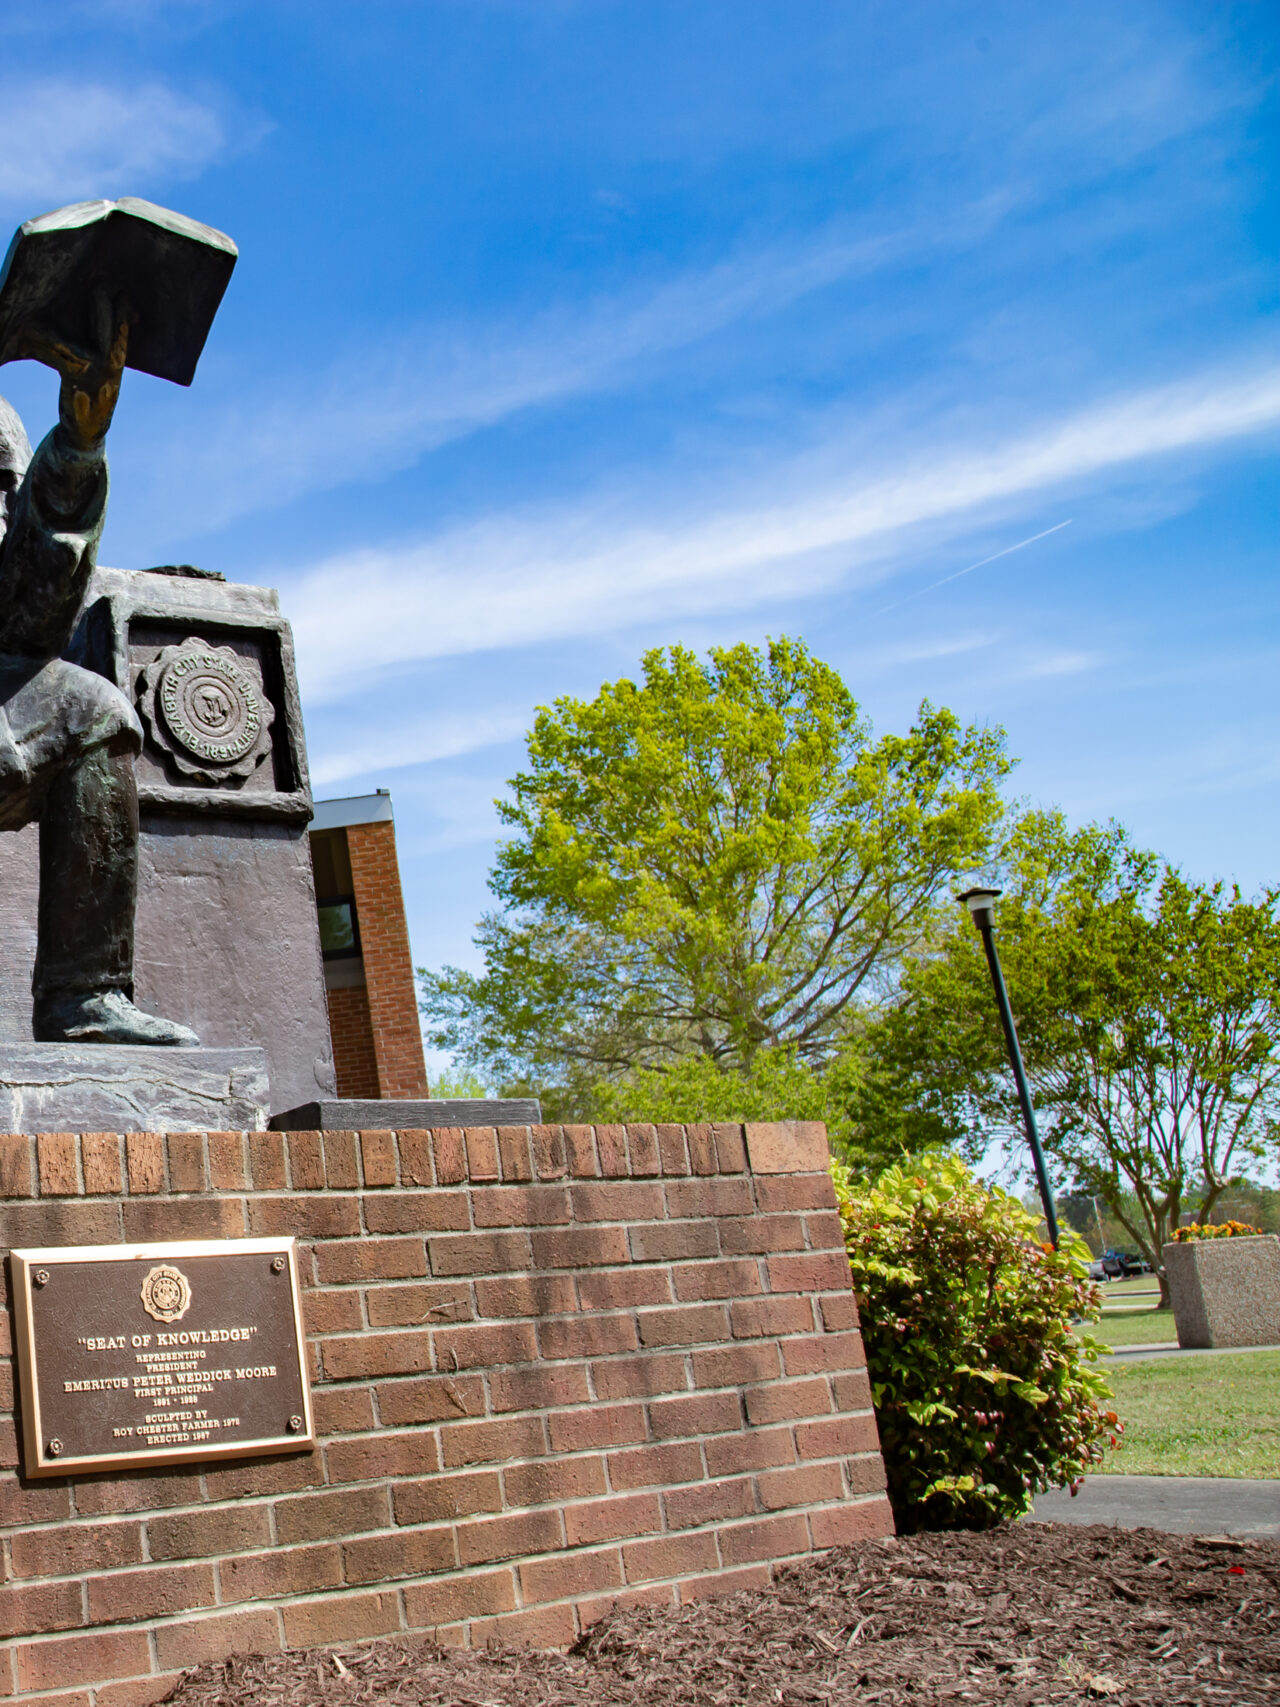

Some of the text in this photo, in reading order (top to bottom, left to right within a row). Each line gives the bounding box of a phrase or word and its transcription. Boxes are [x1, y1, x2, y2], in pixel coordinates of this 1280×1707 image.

[174, 655, 200, 677] CITY
[203, 656, 240, 682] STATE
[234, 680, 261, 752] UNIVERSITY
[204, 743, 234, 759] 1891
[131, 1334, 152, 1348] OF
[136, 1350, 207, 1363] REPRESENTING
[146, 1361, 198, 1373] PRESIDENT
[63, 1366, 277, 1393] EMERITUS PETER WEDDICK MOORE
[134, 1384, 214, 1398] FIRST PRINCIPAL
[145, 1410, 208, 1423] SCULPTED BY
[113, 1427, 133, 1437] ROY
[136, 1422, 179, 1435] CHESTER
[182, 1420, 220, 1431] FARMER
[147, 1433, 189, 1445] ERECTED
